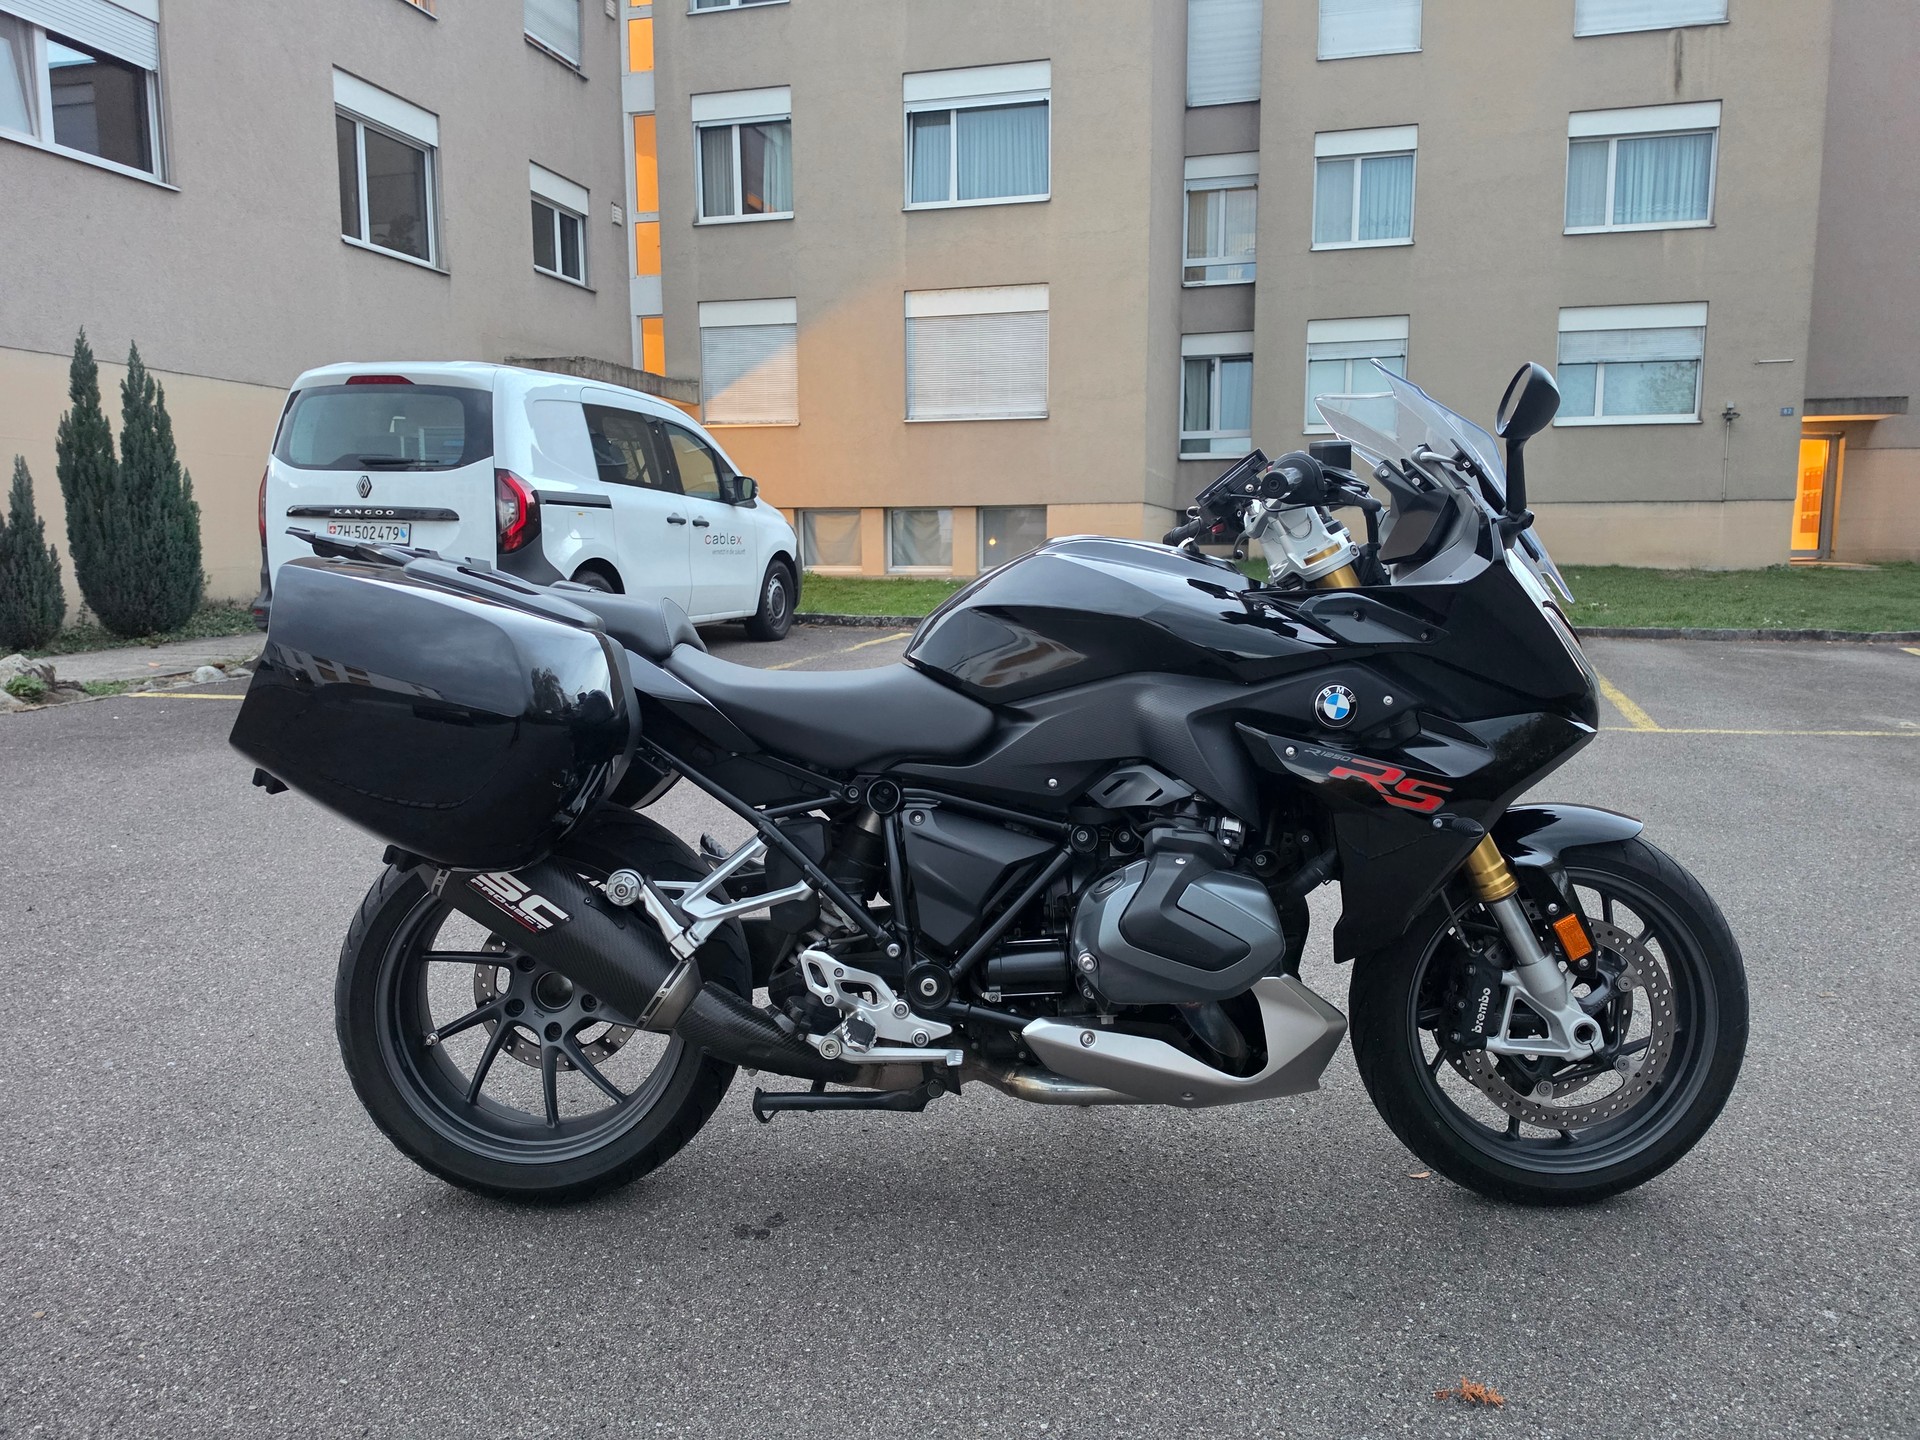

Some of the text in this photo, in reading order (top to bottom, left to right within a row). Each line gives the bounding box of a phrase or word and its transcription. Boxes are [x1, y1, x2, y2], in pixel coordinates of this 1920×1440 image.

[334, 508, 395, 516] KANGOO
[704, 532, 742, 545] cablex
[1322, 686, 1357, 704] BMW
[1328, 758, 1453, 814] RS
[470, 878, 547, 930] PROJECT
[474, 872, 570, 929] SC
[1471, 987, 1492, 1034] brembo
